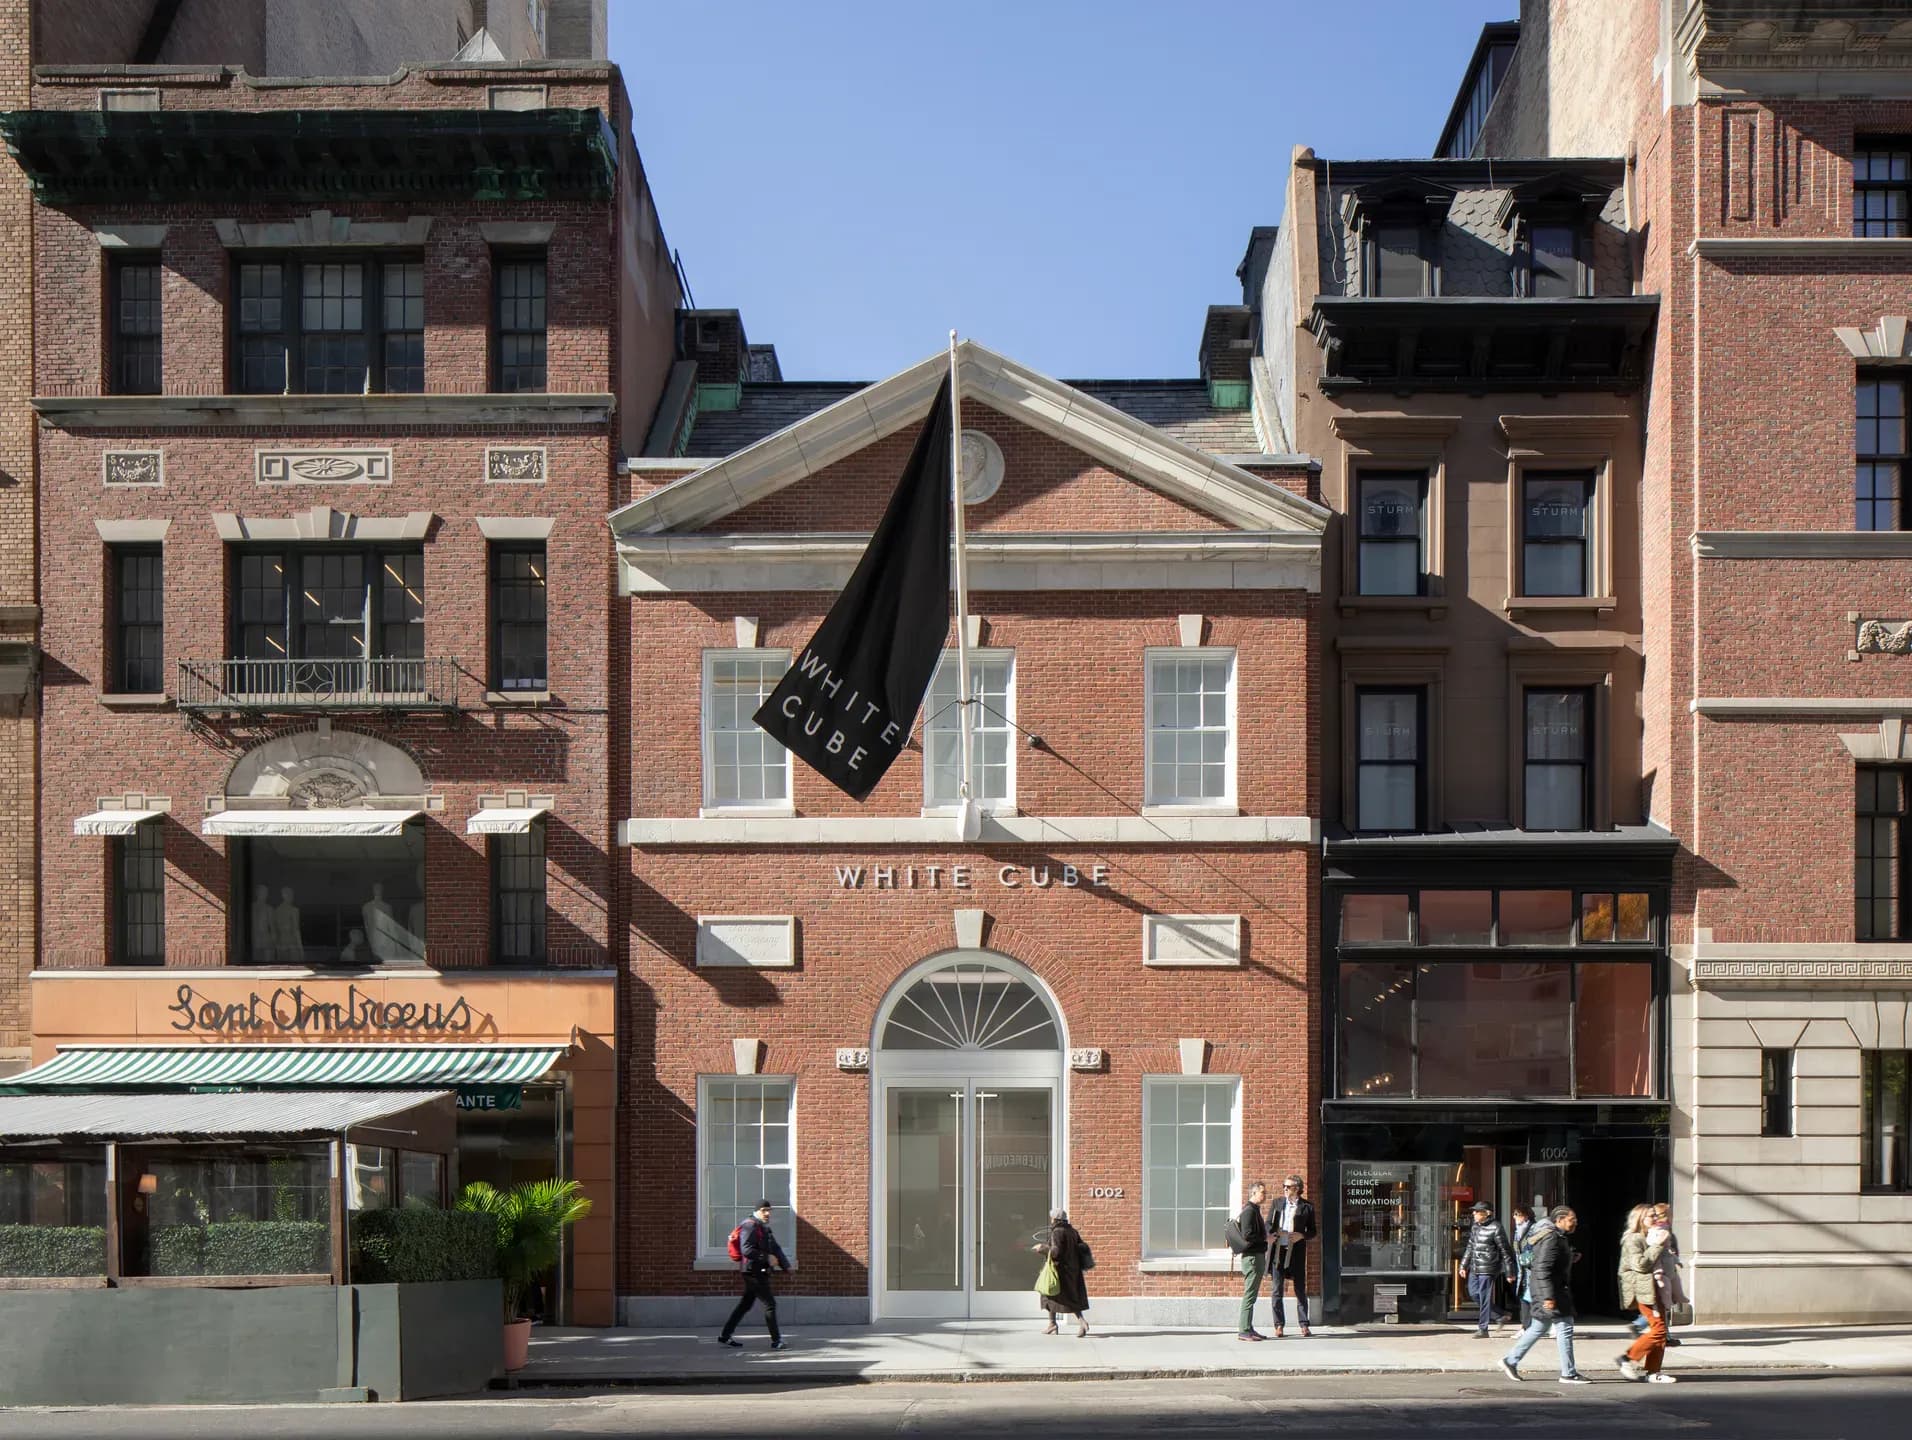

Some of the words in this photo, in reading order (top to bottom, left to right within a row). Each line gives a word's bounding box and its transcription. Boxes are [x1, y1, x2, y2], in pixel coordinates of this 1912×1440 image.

[1531, 507, 1578, 516] STURM
[801, 648, 901, 745] WHITE
[782, 695, 869, 771] CUBE
[835, 865, 970, 888] WHITE
[998, 865, 1111, 888] CUBE
[168, 984, 264, 1031] Sant
[455, 1095, 496, 1107] ANTE
[1540, 1147, 1568, 1159] 1006
[1088, 1187, 1124, 1198] 1002
[1346, 1188, 1372, 1196] SERUM
[1346, 1198, 1402, 1206] INNOVATIONS
